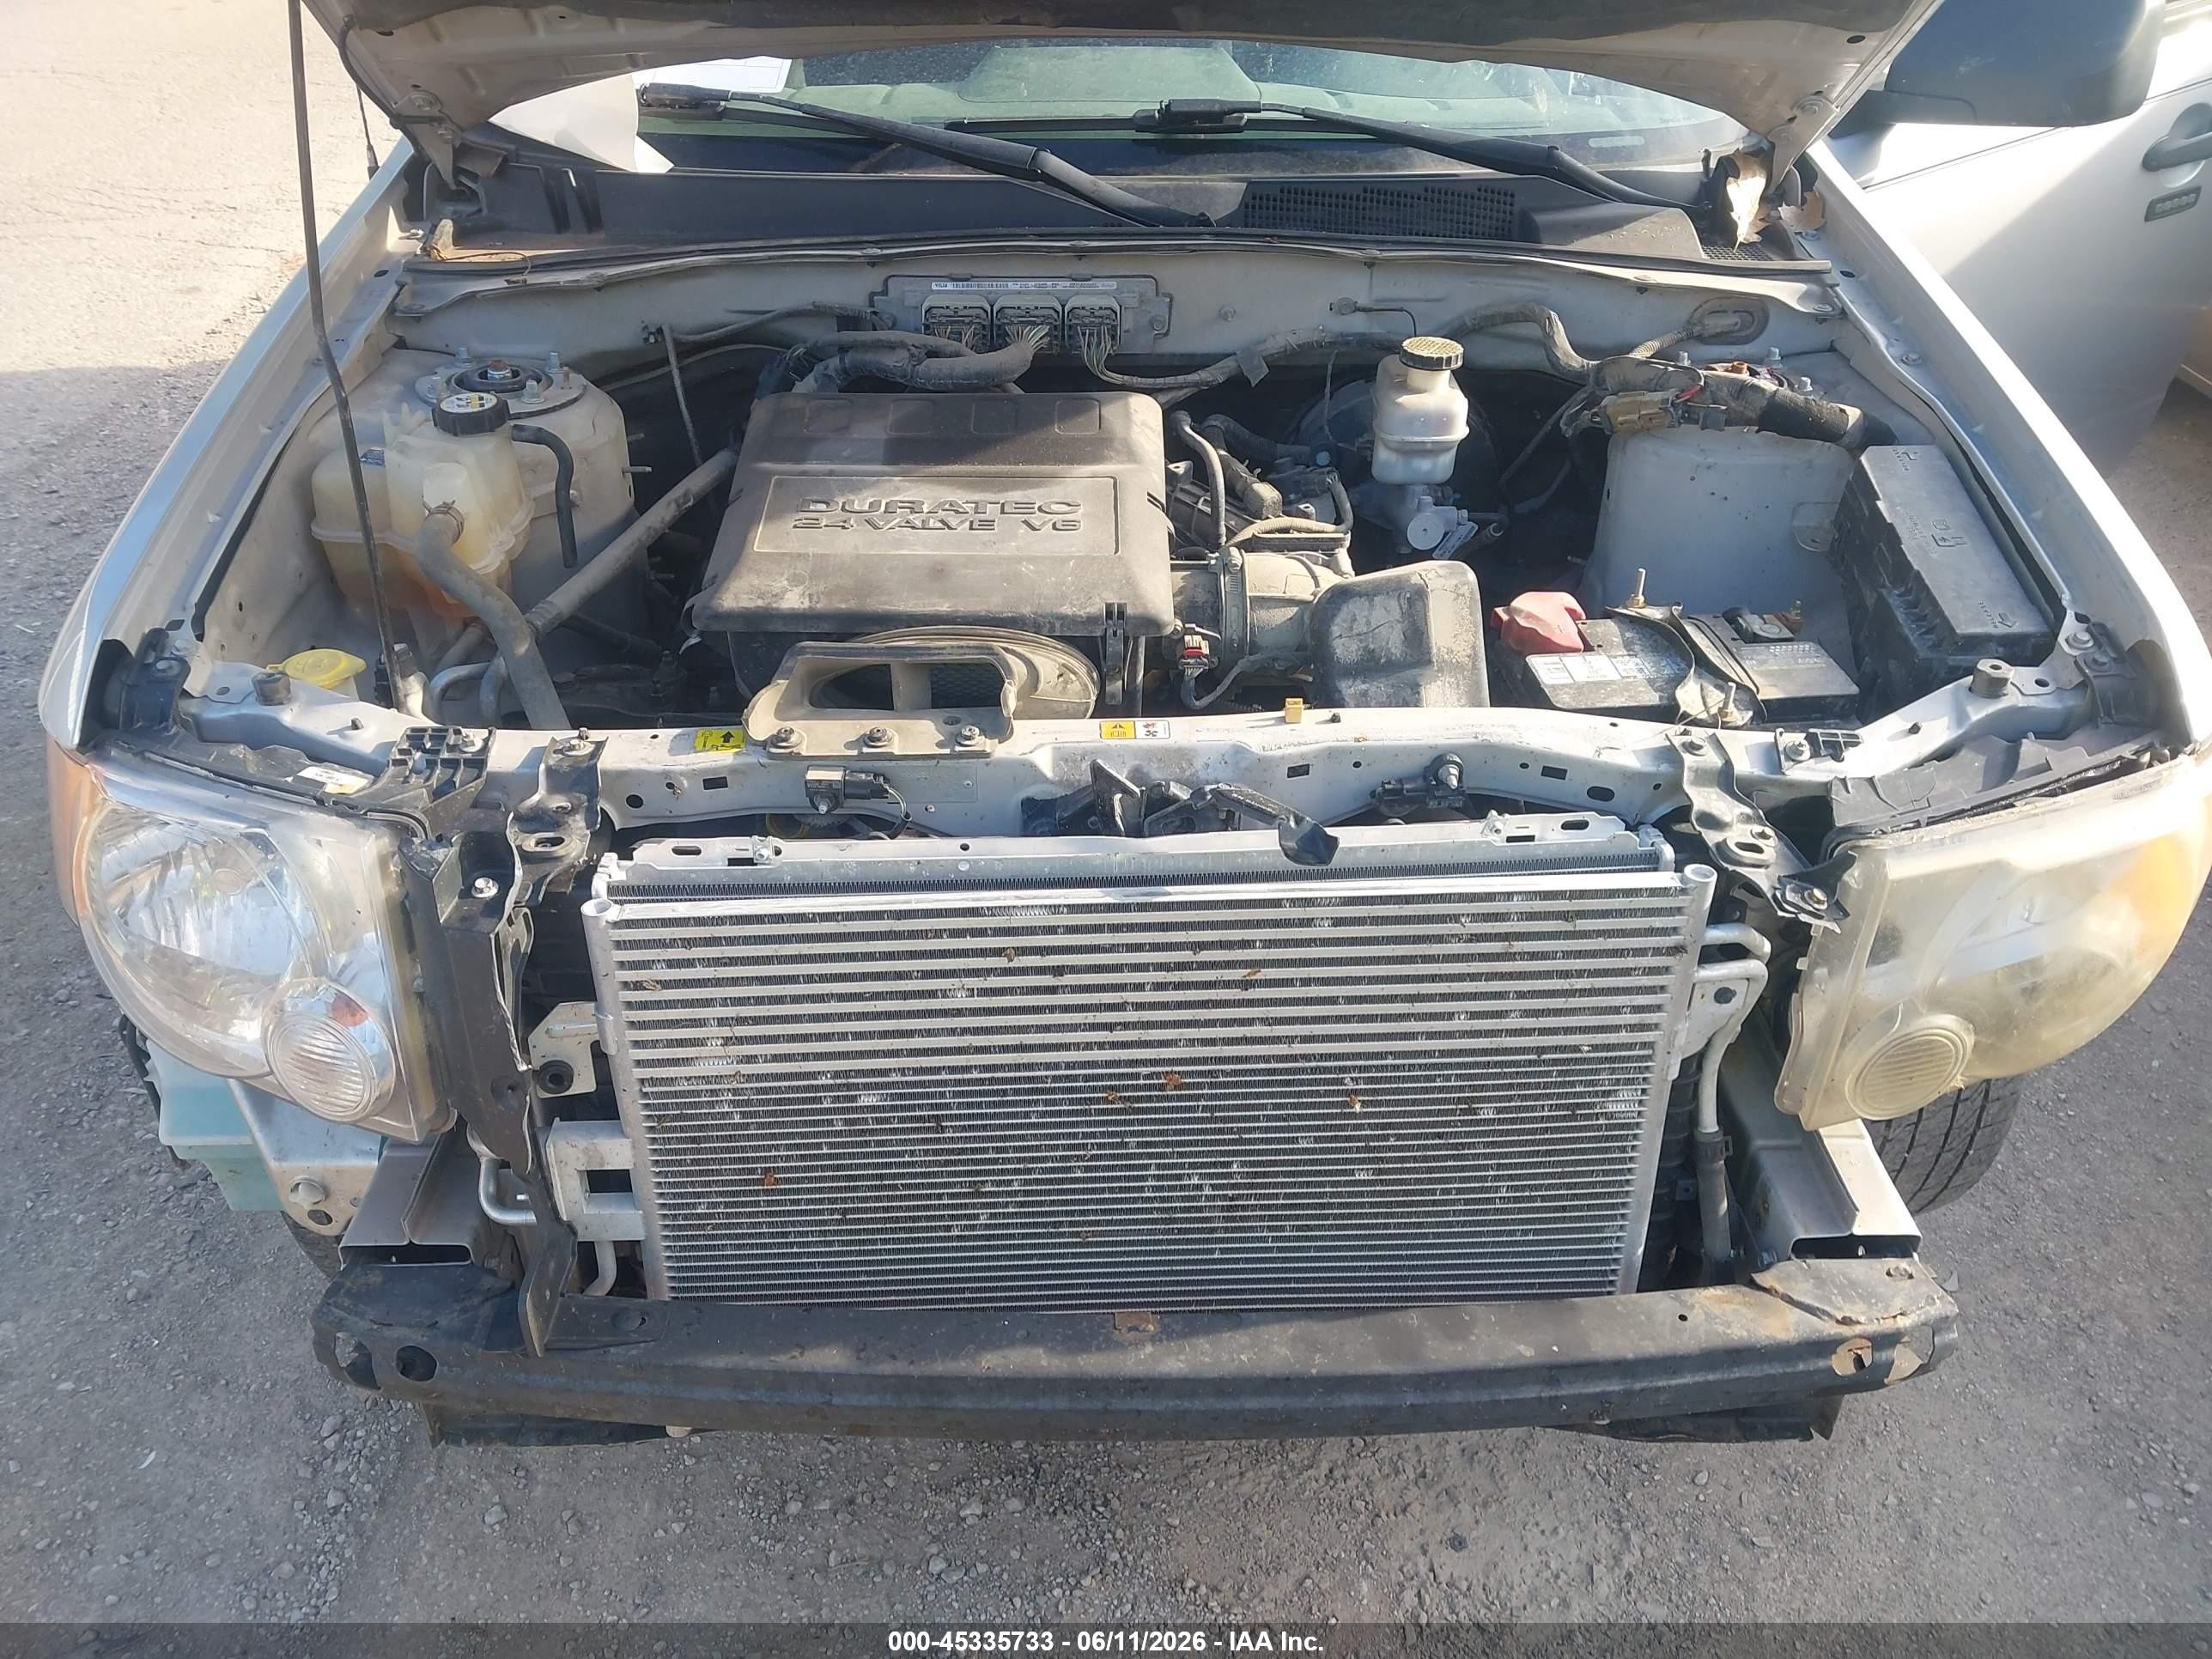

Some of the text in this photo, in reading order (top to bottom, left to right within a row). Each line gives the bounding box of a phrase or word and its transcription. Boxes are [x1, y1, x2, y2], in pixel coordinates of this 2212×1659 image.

[796, 498, 1083, 515] DURATEC
[793, 516, 1082, 532] 24 VALVE V6
